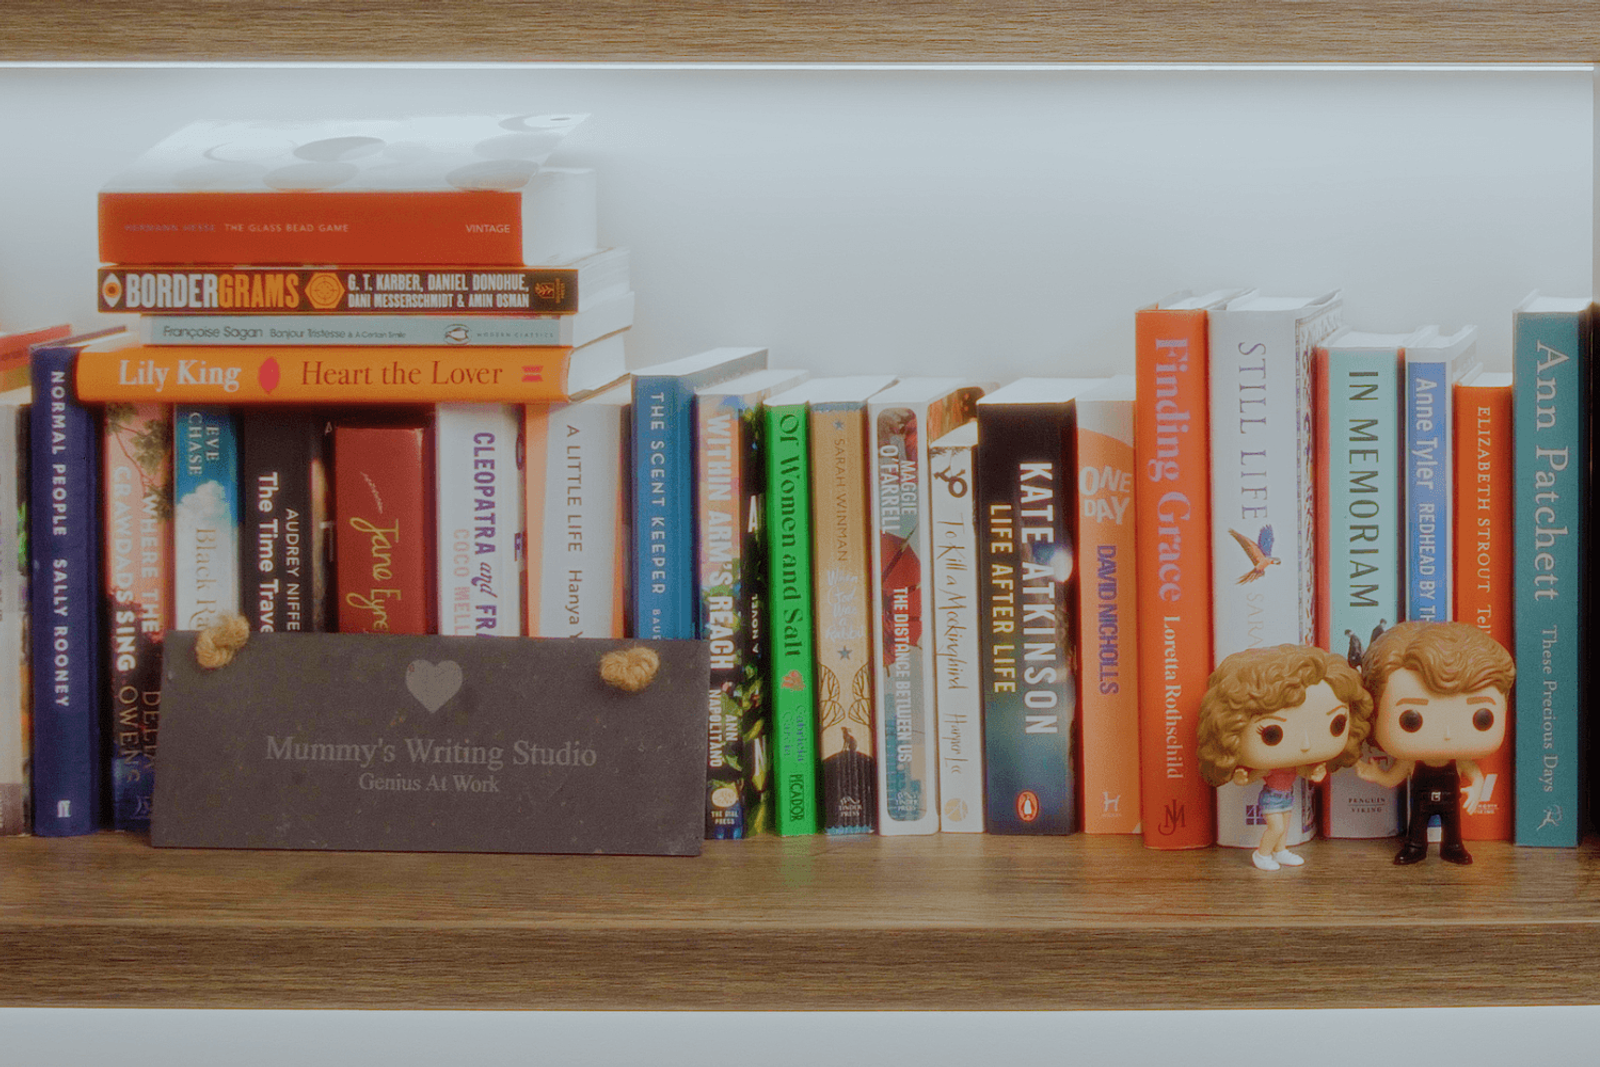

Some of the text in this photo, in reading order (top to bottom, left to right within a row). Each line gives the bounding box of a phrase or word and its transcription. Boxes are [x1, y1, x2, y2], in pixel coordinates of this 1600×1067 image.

[225, 223, 349, 233] THE GLASS BEAD GAME
[465, 224, 511, 234] VINTAGE
[125, 273, 300, 309] BORDERGRAMS
[347, 274, 530, 293] G. T. KARBER, DANIEL DONOHUE,
[348, 293, 530, 309] DANI MESSERSCHMIDT & AMIN OSMAN
[163, 325, 263, 341] Françoise Sagan
[269, 328, 305, 340] Bonjour
[307, 329, 346, 339] Tristesse
[355, 330, 361, 338] A
[388, 330, 407, 339] Smile
[118, 359, 243, 393] Lily King
[301, 360, 503, 386] Heart the Lover
[51, 370, 68, 536] NORMAL PEOPLE
[188, 411, 203, 476] CHASE
[206, 426, 220, 462] EVE
[1237, 341, 1268, 520] STILL LIFE
[1411, 377, 1439, 490] Anne Tyler
[258, 471, 279, 513] The
[566, 424, 583, 552] A LITTLE LIFE
[650, 392, 667, 594] THE SCENT KEEPER
[780, 454, 800, 548] Women
[833, 438, 849, 562] SARAH WINMAN
[879, 444, 901, 535] O'FARRELL
[900, 460, 918, 516] MAGGIE
[1079, 465, 1133, 496] ONE
[1147, 337, 1192, 602] Finding Grace
[1348, 371, 1380, 607] IN MEMORIAM
[1477, 406, 1492, 594] ELIZABETH STROUT
[1534, 339, 1571, 602] Ann Patchett
[259, 518, 279, 573] Time
[285, 508, 300, 578] AUDREY
[470, 432, 498, 639] CLEOPATRA and FR
[706, 413, 735, 670] WITHIN ARM'S REACH
[1083, 497, 1130, 525] DAY
[1418, 502, 1437, 576] REDHEAD
[113, 466, 137, 672] CRAWDADS SING
[140, 495, 160, 634] WHERE THE
[195, 528, 217, 584] Black
[345, 516, 402, 631] Jane Eyre
[453, 529, 471, 578] COCO
[782, 553, 802, 601] and
[565, 570, 583, 625] Hanya
[751, 593, 760, 653] A NOVEL
[936, 513, 969, 690] To Kill a Mockingbird
[990, 504, 1016, 693] LIFE AFTER LIFE
[1019, 462, 1058, 735] KATE ATKINSON
[1096, 545, 1120, 695] DAVID NICHOLLS
[1418, 579, 1436, 601] BY
[53, 559, 70, 707] SALLY ROONEY
[783, 608, 804, 657] Salt
[893, 587, 913, 764] THE DISTANCE BETWEEN US
[1163, 615, 1184, 779] Loretta Rothschild
[1538, 624, 1559, 793] These Precious Days
[118, 685, 141, 783] OWENS
[265, 735, 598, 772] Mummy's Writing Studio
[708, 688, 724, 768] NAPOLITANO
[725, 714, 738, 742] ANN
[358, 772, 500, 794] Genius At Work
[789, 774, 805, 822] PICADOR
